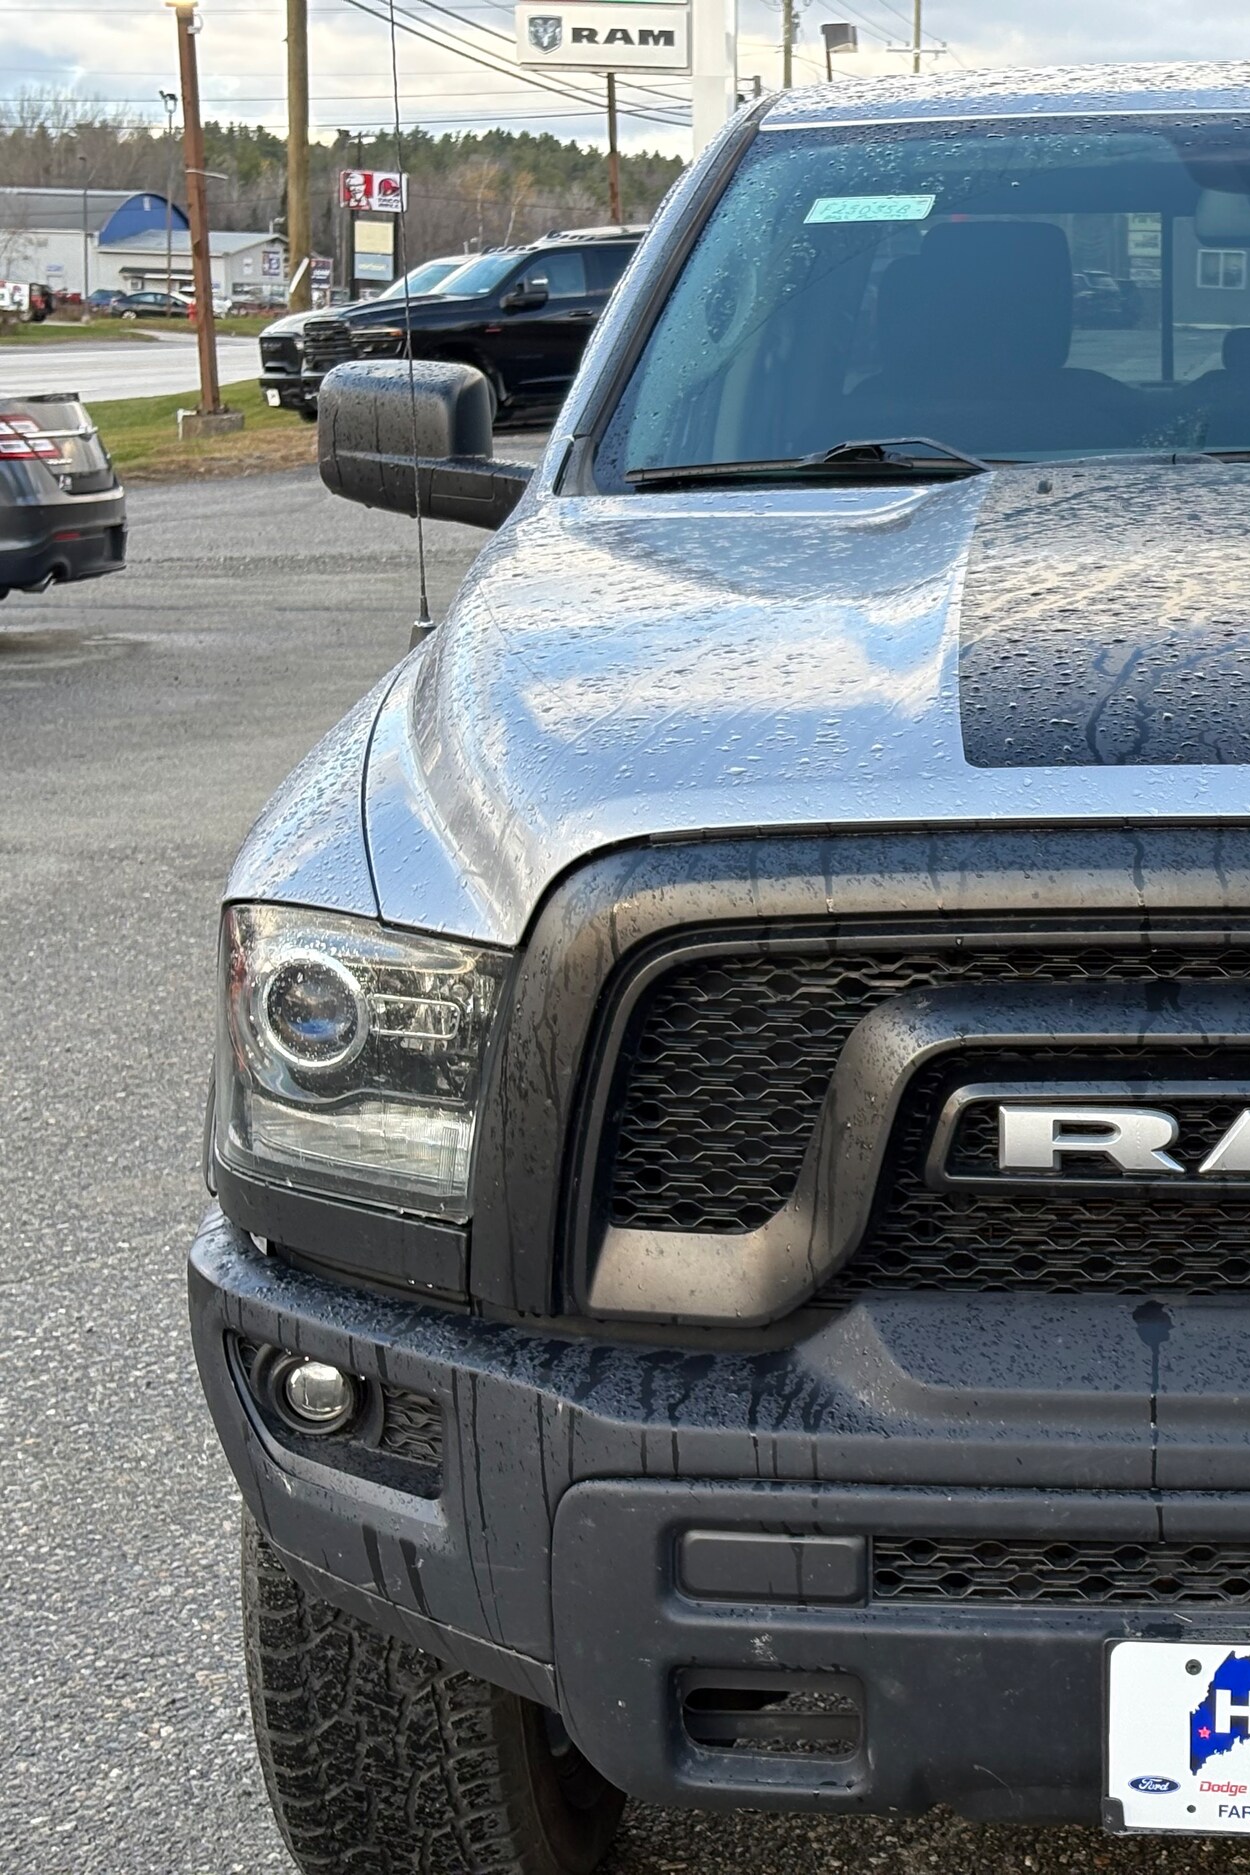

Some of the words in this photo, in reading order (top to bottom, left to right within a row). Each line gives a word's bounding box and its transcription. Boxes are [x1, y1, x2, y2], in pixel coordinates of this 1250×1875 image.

[571, 27, 675, 47] RAM
[1138, 1778, 1170, 1791] Ford
[1200, 1781, 1248, 1796] Dodge
